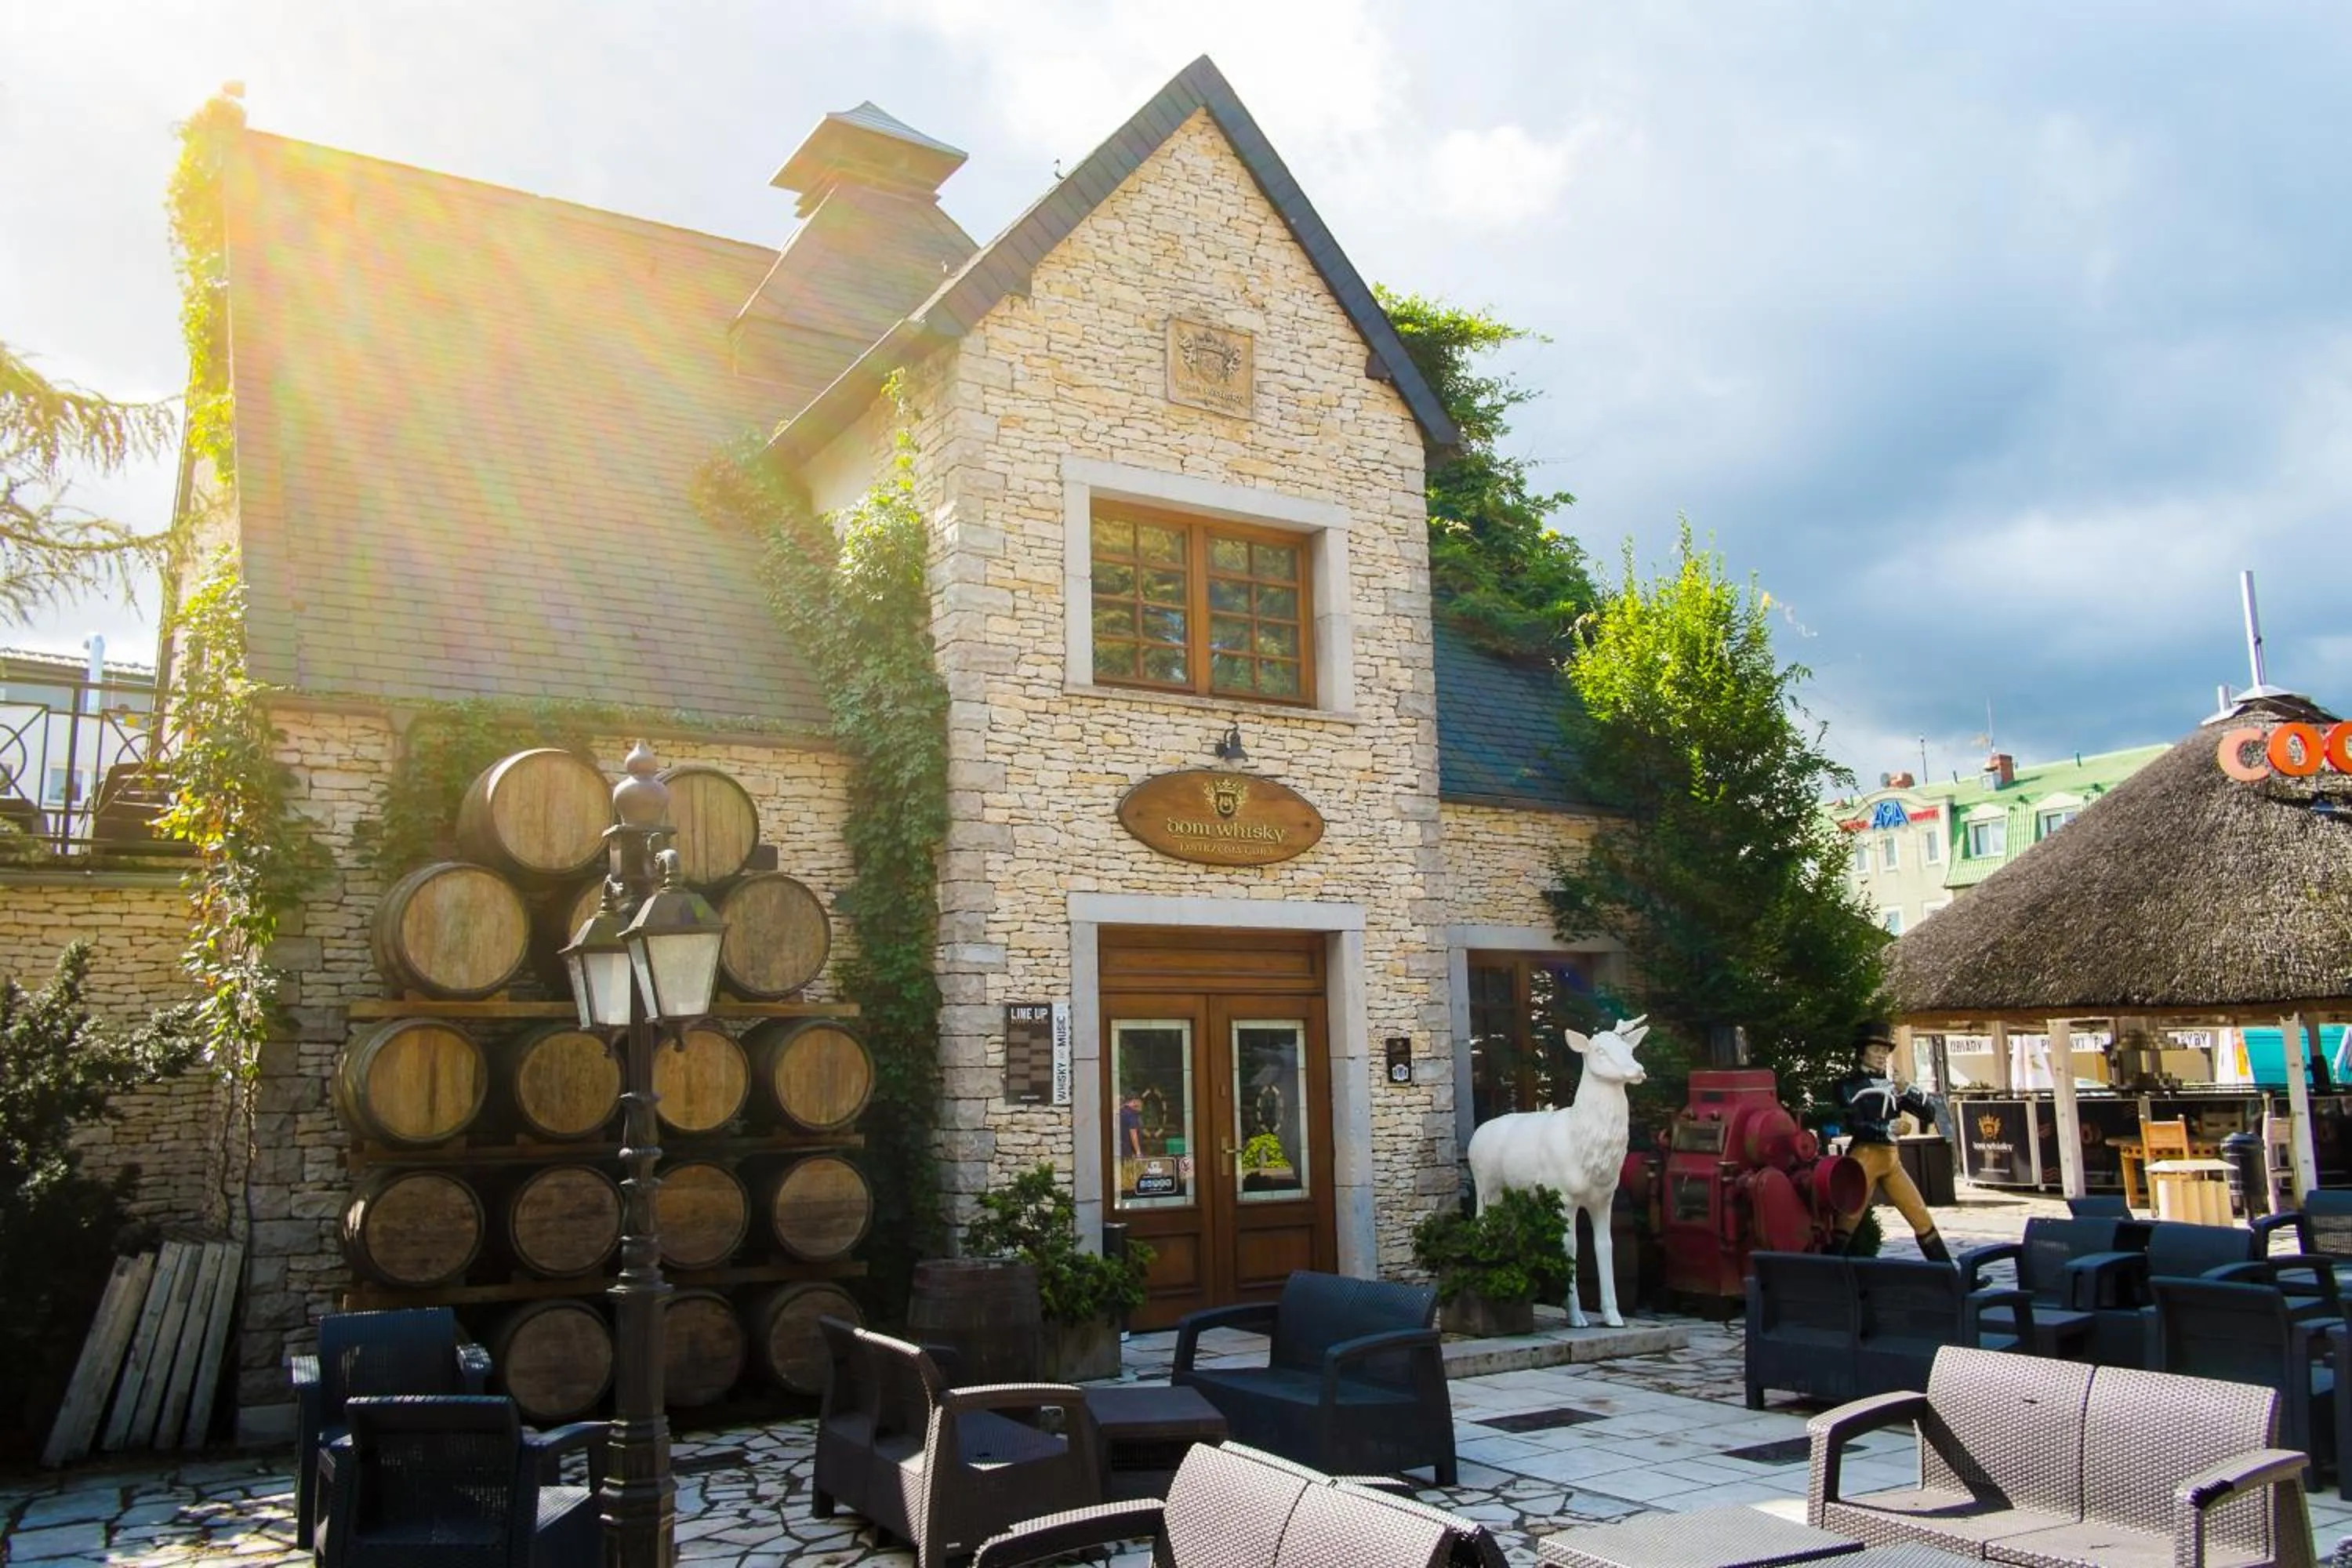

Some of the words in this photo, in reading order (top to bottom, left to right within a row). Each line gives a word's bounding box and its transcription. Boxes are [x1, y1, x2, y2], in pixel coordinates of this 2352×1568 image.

[1167, 817, 1210, 835] dom
[1216, 823, 1286, 844] whisky
[1011, 1007, 1033, 1019] LINE
[1034, 1007, 1048, 1019] UP
